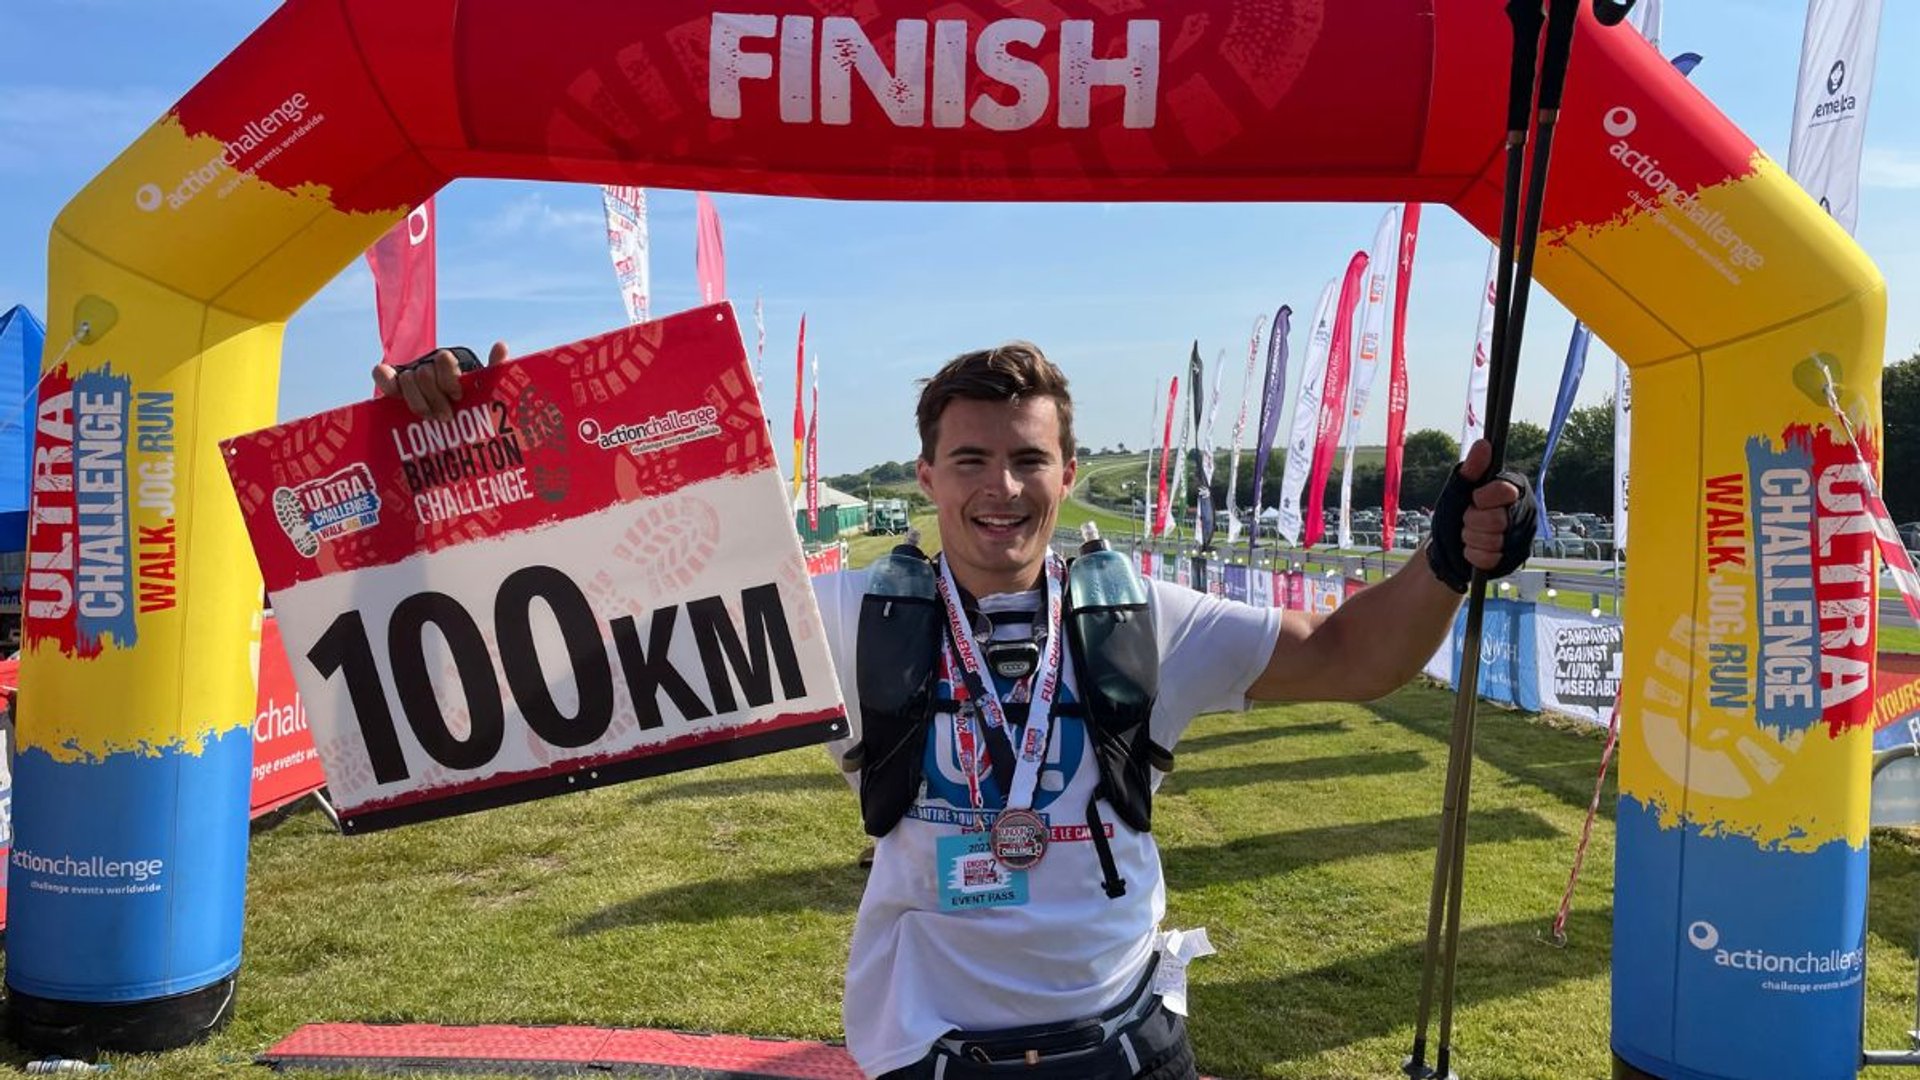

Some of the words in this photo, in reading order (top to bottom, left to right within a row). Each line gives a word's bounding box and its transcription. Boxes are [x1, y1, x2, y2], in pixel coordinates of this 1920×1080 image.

[709, 12, 1160, 131] FINISH
[166, 92, 310, 210] actionchallenge
[392, 404, 496, 461] LONDON
[492, 402, 513, 435] 2
[600, 407, 716, 448] actionchallenge
[403, 434, 524, 496] BRIGHTON
[28, 391, 74, 619] ULTRA
[78, 391, 125, 618] CHALLENGE
[304, 475, 368, 511] ULTRA
[313, 496, 373, 526] CHALLENGE
[414, 467, 534, 524] CHALLENGE
[1760, 468, 1815, 709] CHALLENGE
[1817, 463, 1872, 709] ULTRA
[1555, 645, 1608, 662] AGAINST
[1557, 626, 1621, 646] CAMPAIGN
[1555, 662, 1601, 679] LIVING
[273, 750, 305, 772] events
[1061, 827, 1072, 841] LE
[106, 882, 161, 895] worldwide
[951, 892, 986, 906] EVENT
[988, 890, 1015, 902] PASS
[1762, 980, 1811, 993] challenge
